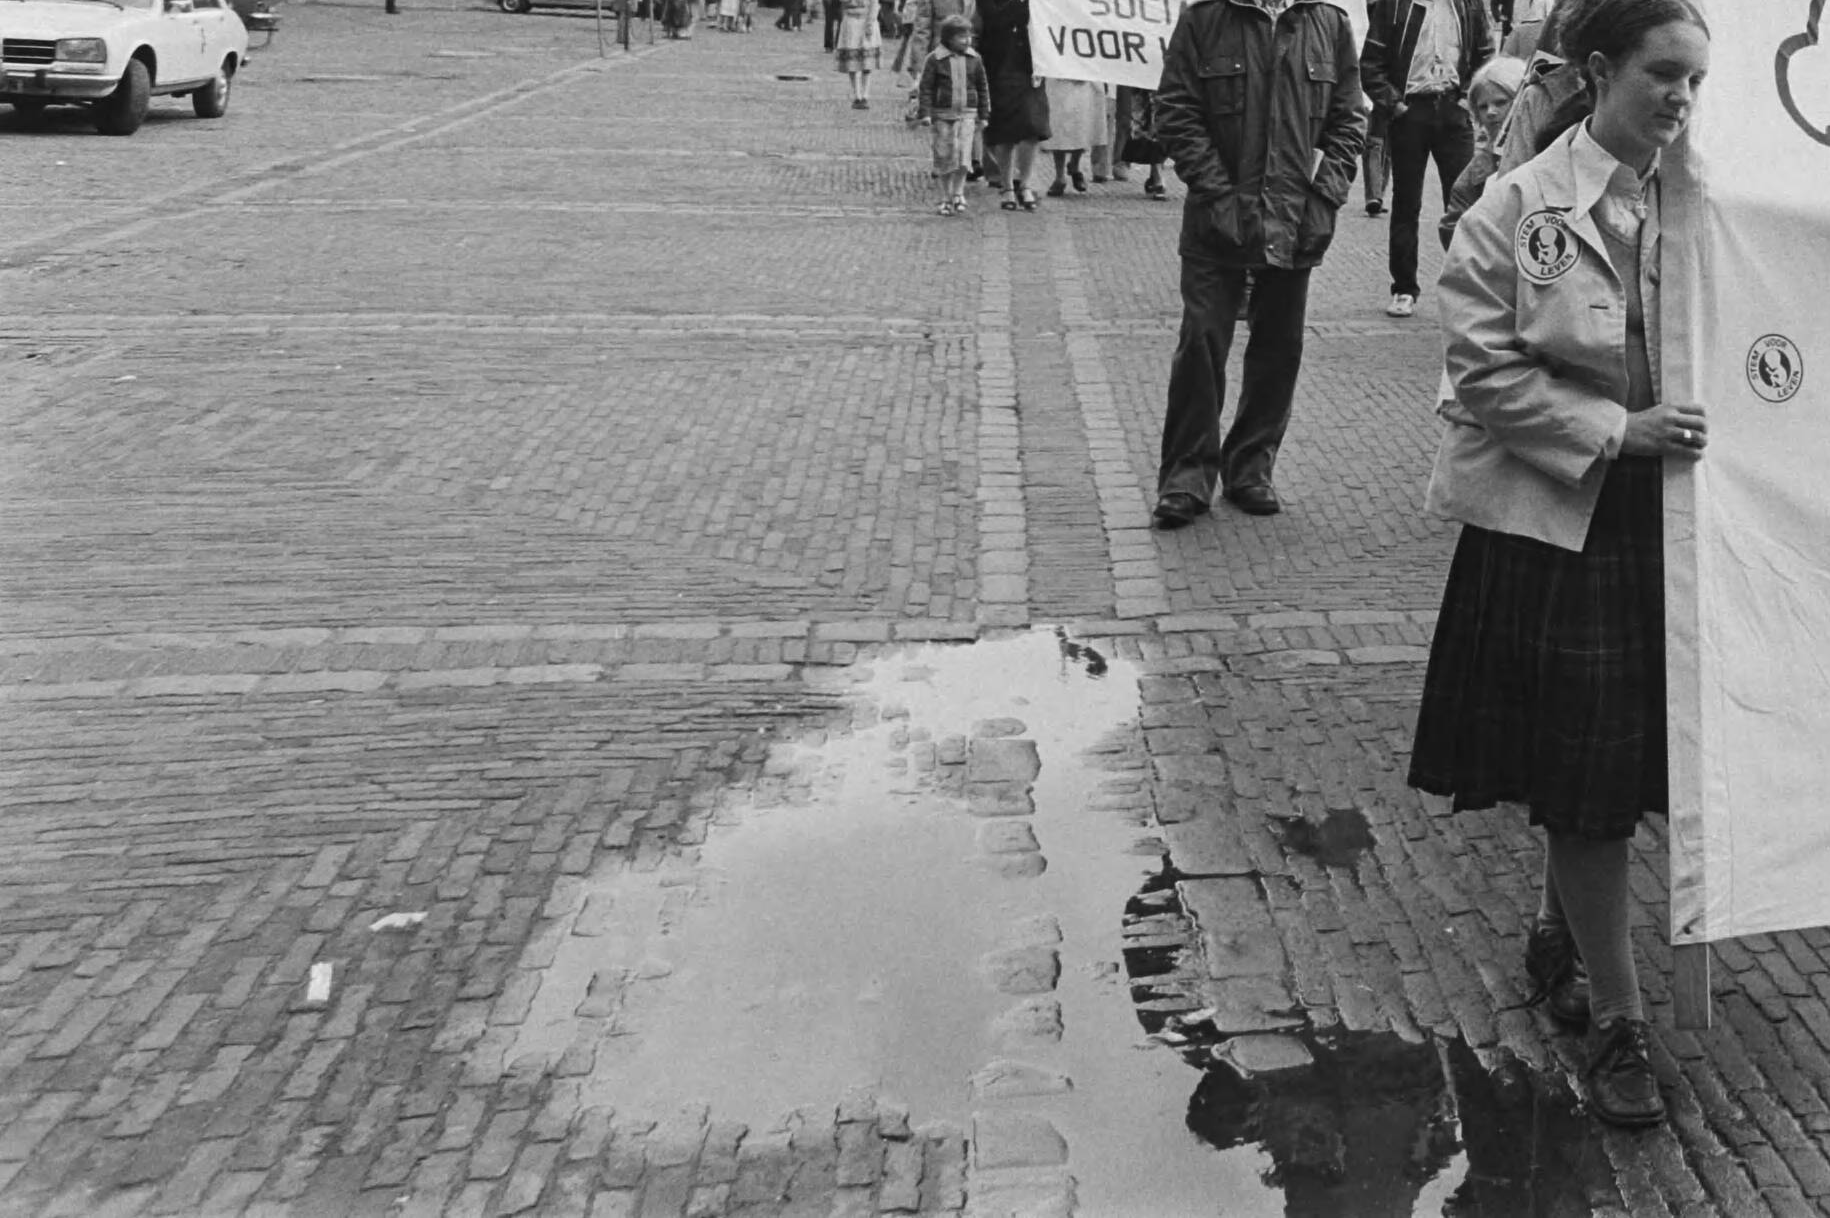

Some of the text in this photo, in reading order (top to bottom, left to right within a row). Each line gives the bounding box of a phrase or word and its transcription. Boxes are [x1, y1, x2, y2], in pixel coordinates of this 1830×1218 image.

[1047, 25, 1149, 65] VOOR
[1519, 218, 1535, 248] STEM
[1540, 252, 1574, 276] LEVEN
[1750, 350, 1760, 380] STEM
